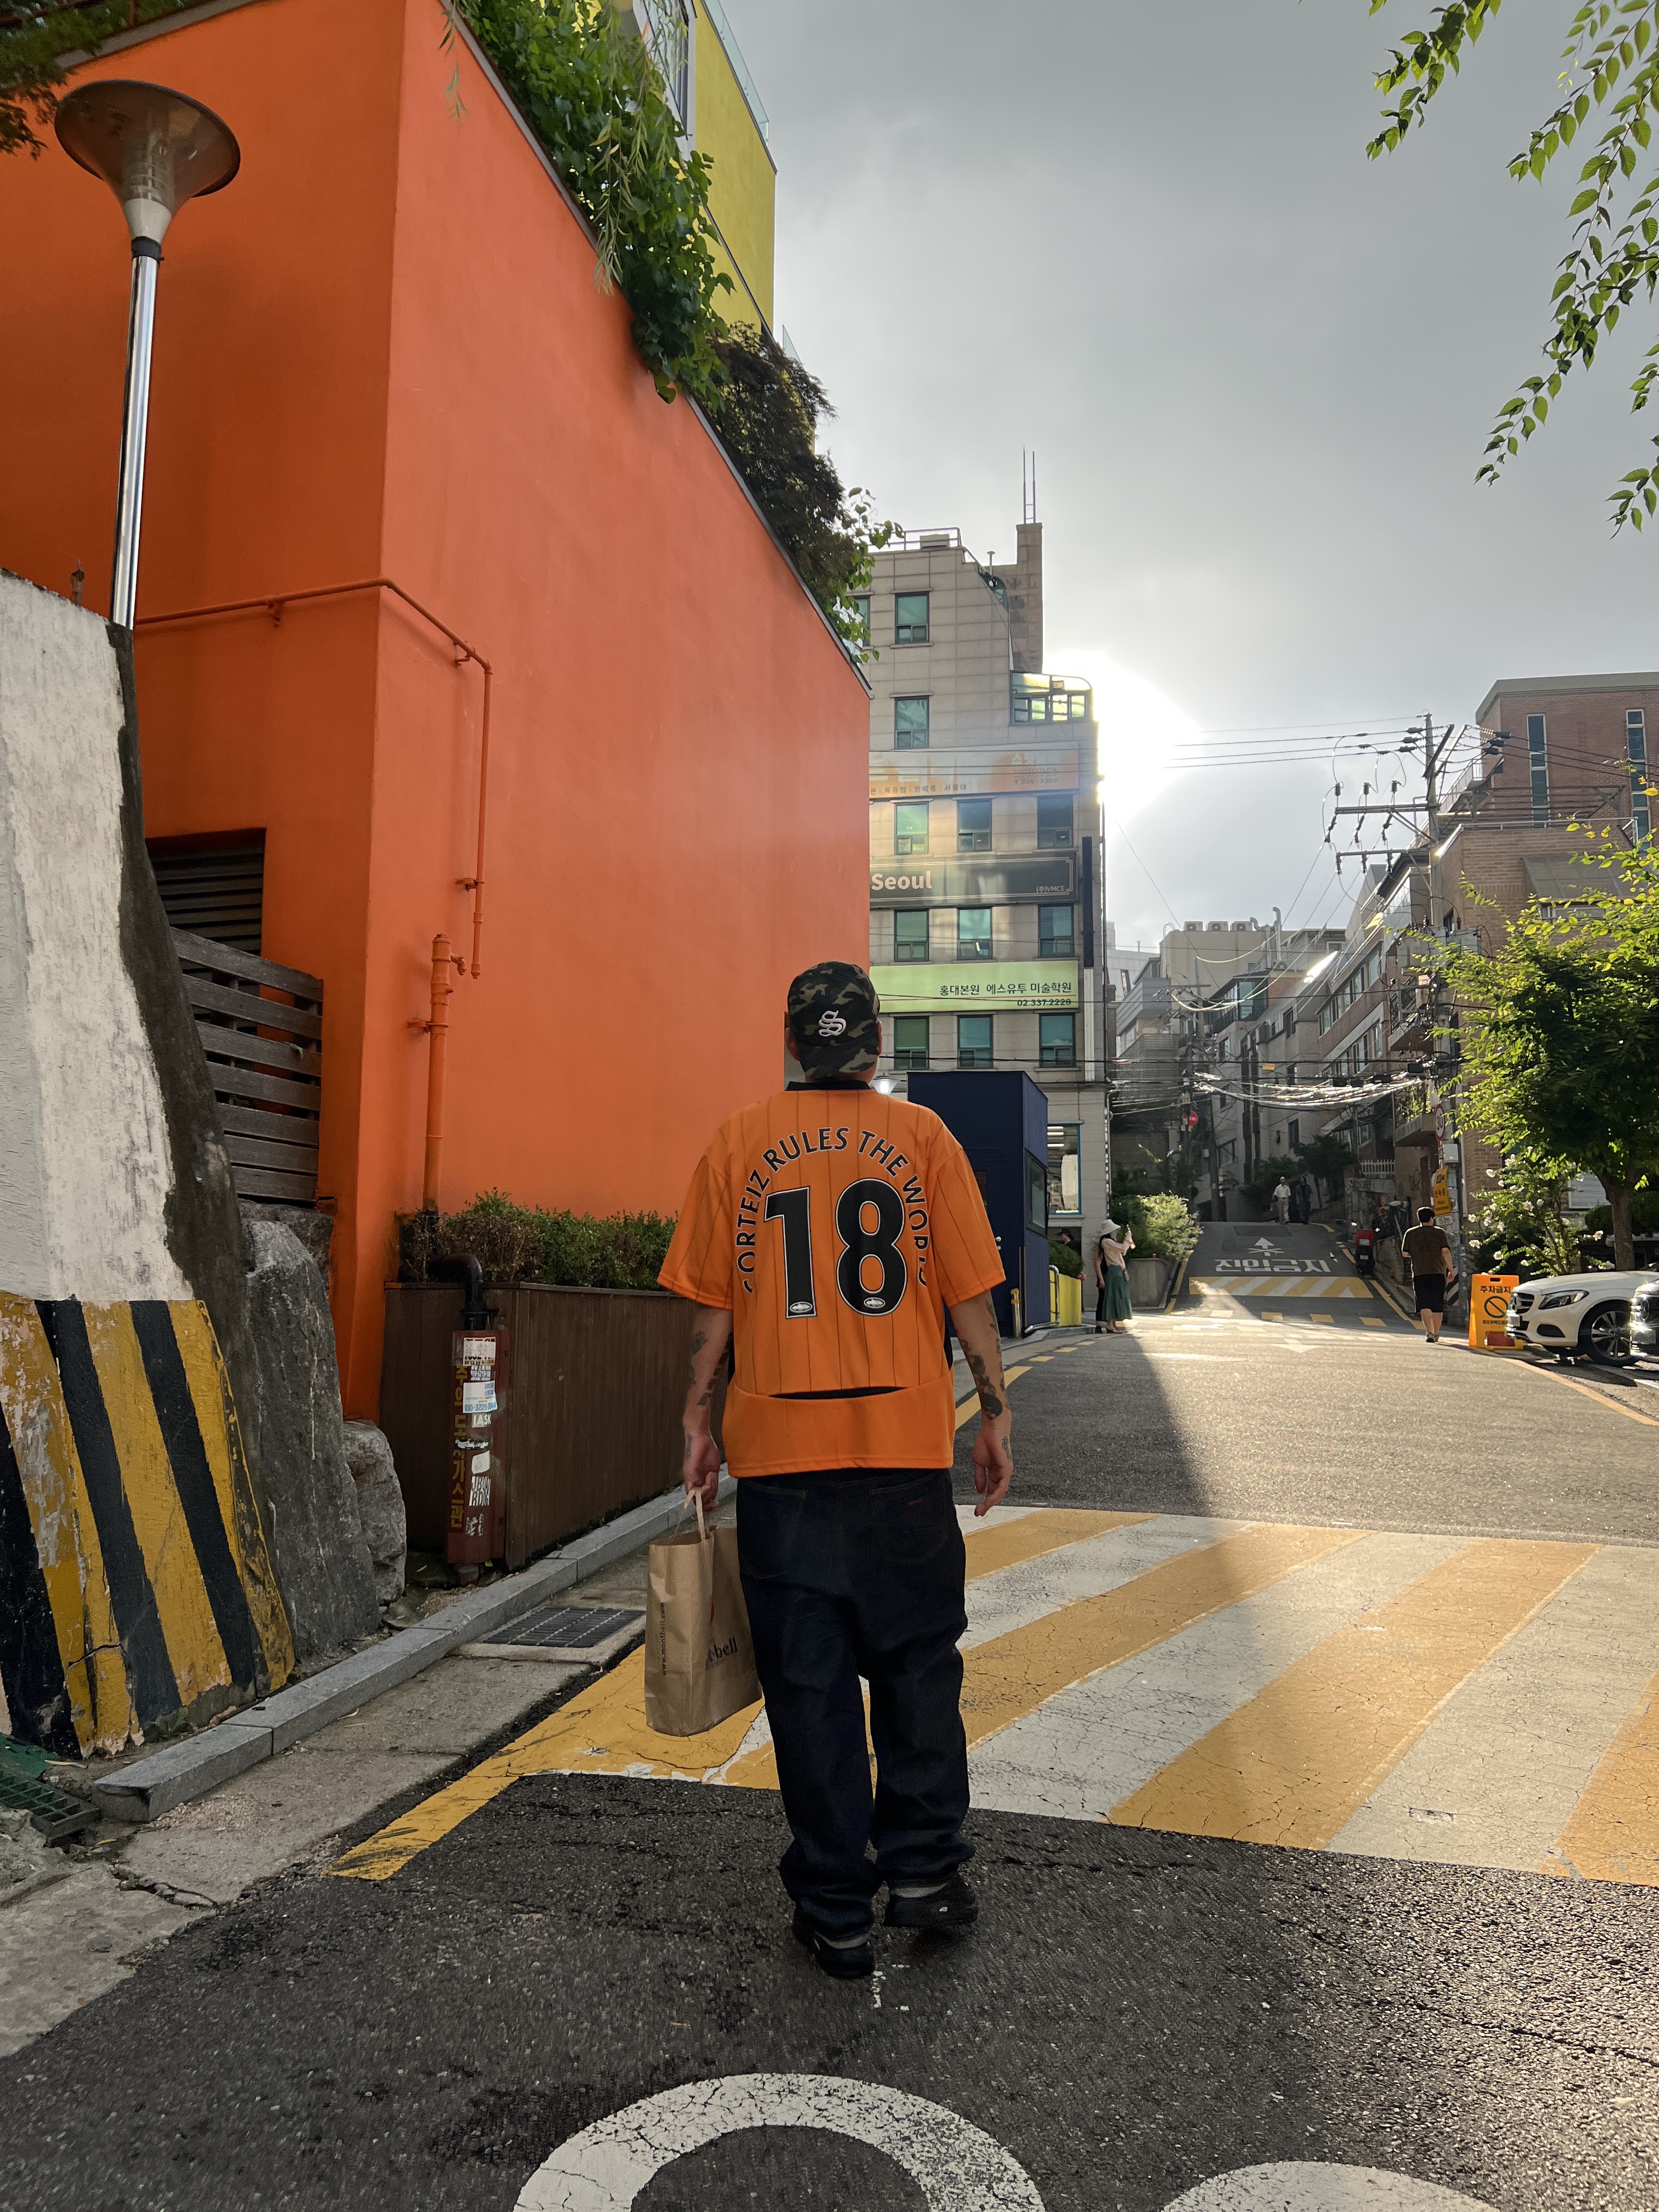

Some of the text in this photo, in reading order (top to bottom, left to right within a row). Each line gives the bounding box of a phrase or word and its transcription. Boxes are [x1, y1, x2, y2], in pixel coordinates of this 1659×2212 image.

[871, 871, 932, 891] Seoul
[940, 982, 1072, 996] 홍대본원 에스유투 미술학원
[1436, 1114, 1443, 1131] 30
[762, 1126, 850, 1173] RULES
[857, 1130, 910, 1177] THE
[763, 1177, 907, 1320] 18
[1214, 1259, 1331, 1272] 진입금지
[1480, 1285, 1511, 1294] 주차금지
